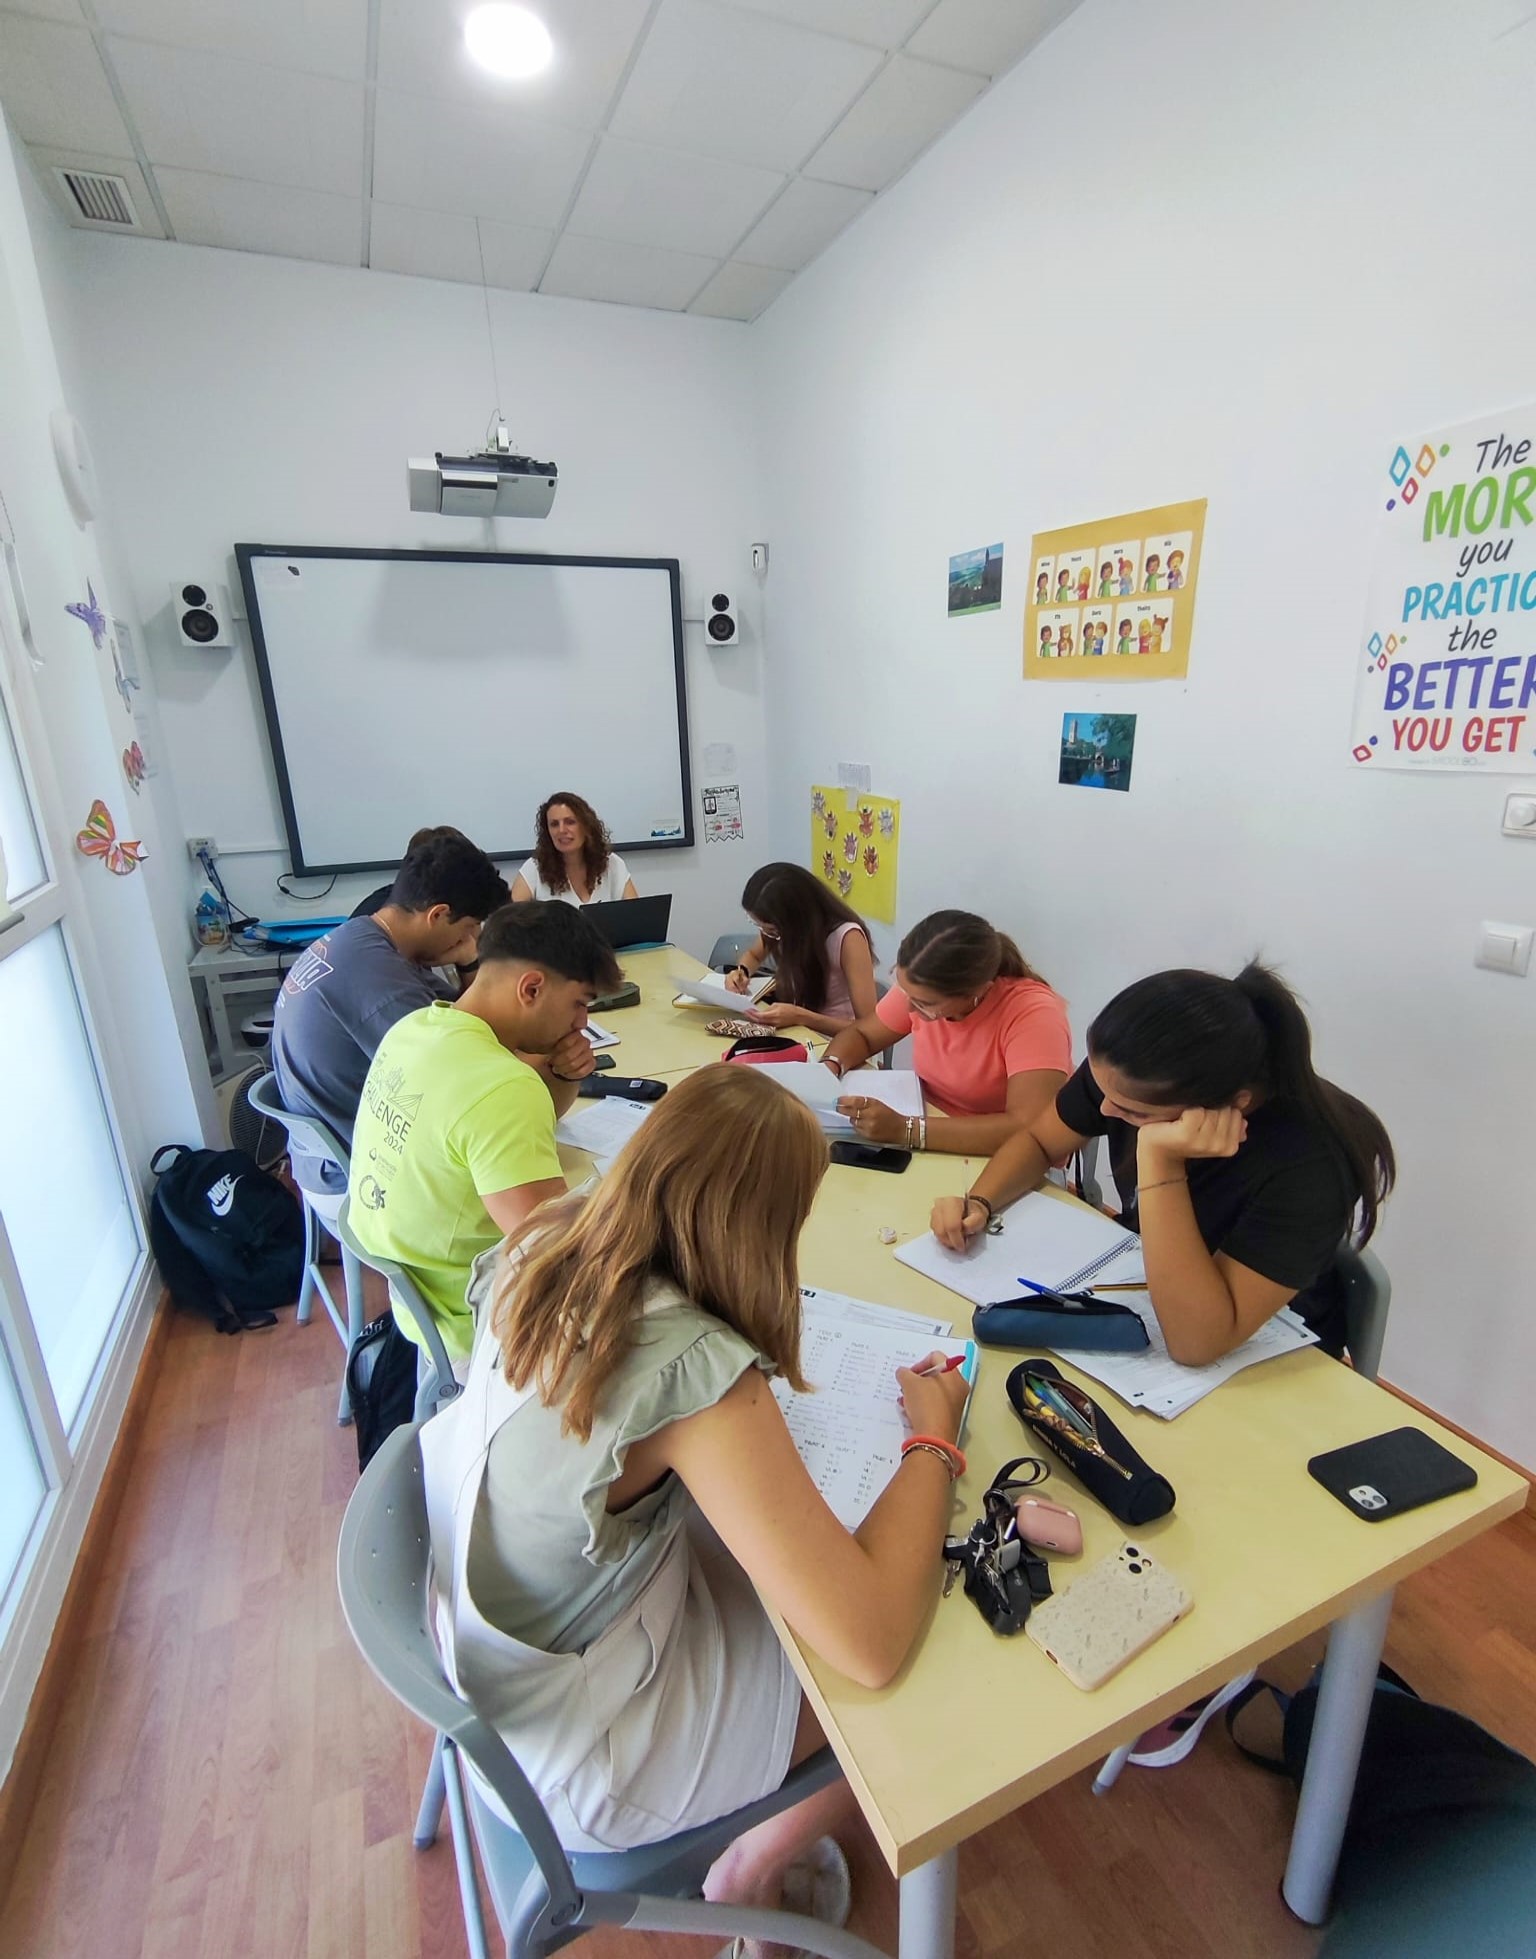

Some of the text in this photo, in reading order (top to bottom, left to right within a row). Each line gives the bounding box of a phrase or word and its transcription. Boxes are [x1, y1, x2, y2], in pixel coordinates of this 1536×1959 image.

[1476, 433, 1532, 473] The
[1456, 538, 1514, 578] you
[1448, 619, 1498, 652] the
[1392, 715, 1526, 753] YOU GET
[384, 1131, 403, 1155] 2024
[207, 1173, 231, 1205] NIKE
